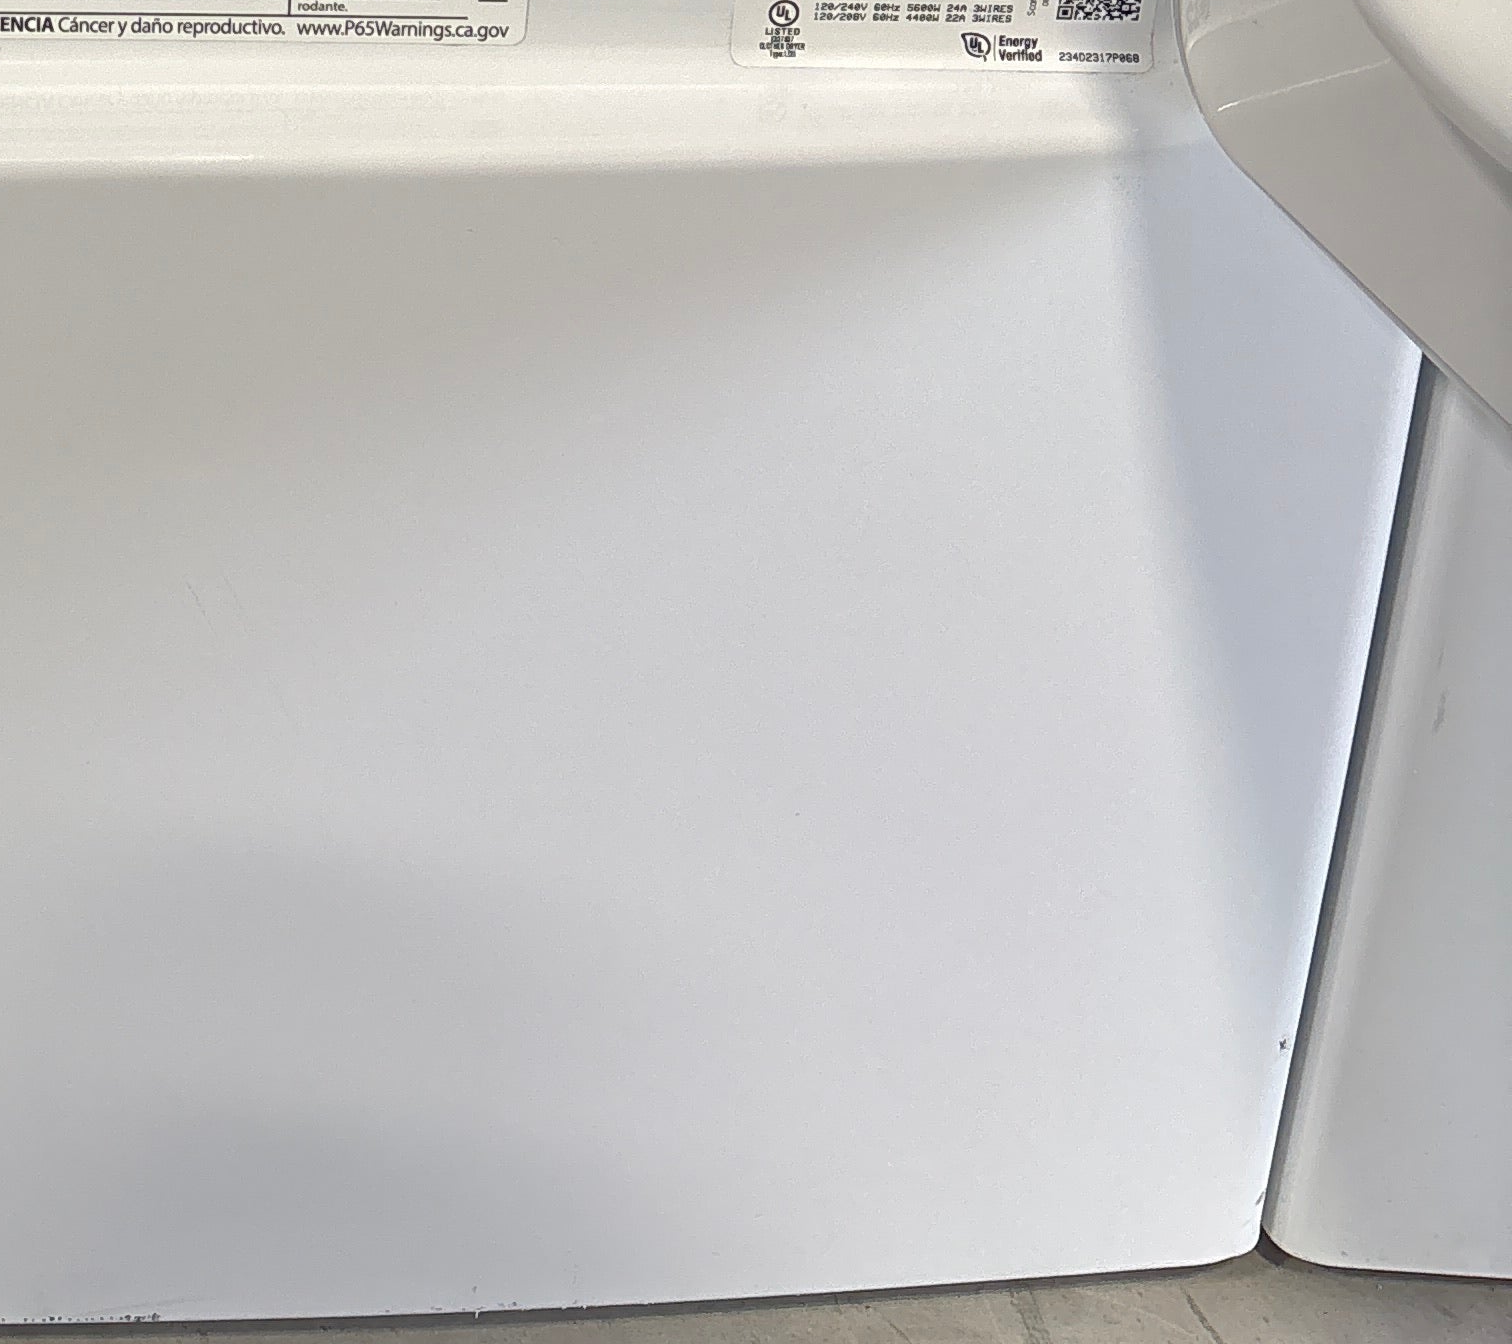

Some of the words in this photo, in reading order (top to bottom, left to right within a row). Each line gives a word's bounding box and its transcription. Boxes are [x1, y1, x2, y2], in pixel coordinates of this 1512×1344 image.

[814, 3, 868, 11] 120/240V
[873, 3, 901, 12] 60Hz
[907, 3, 941, 12] 5600W
[946, 4, 967, 12] 24A
[973, 4, 1014, 13] 3WIRES
[58, 18, 114, 32] Cáncer
[117, 21, 127, 36] y
[130, 18, 173, 33] daño
[177, 19, 285, 38] reproductivo.
[296, 20, 509, 41] www.P65Warnings.ca.gov
[765, 27, 801, 36] LISTED
[999, 35, 1039, 48] Energy
[999, 49, 1043, 62] Verified
